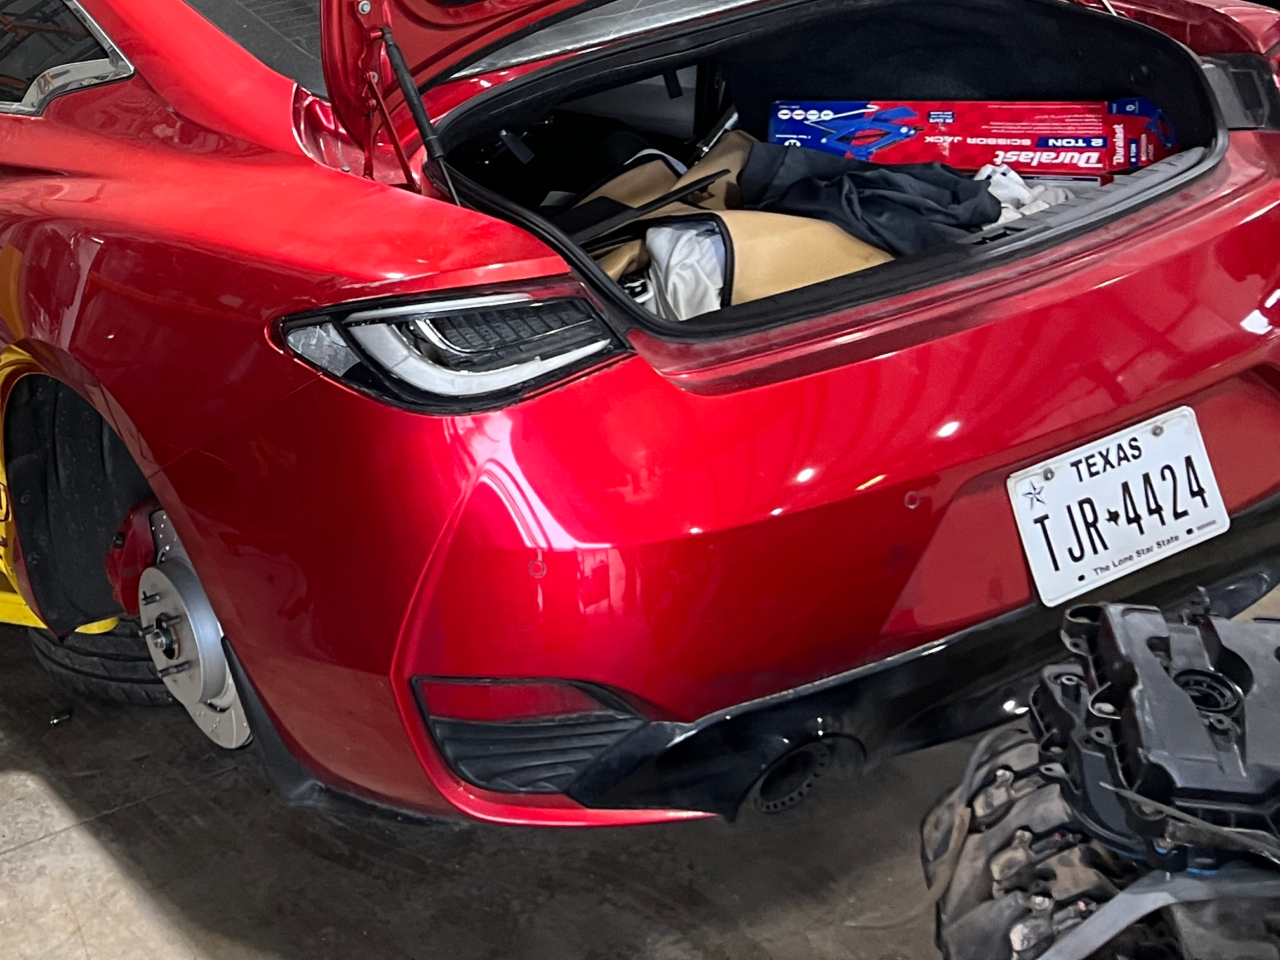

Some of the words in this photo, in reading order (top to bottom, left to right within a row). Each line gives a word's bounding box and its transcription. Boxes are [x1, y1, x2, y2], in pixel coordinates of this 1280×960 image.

[924, 136, 963, 144] JACK
[966, 137, 1032, 145] SCISSOR
[1048, 138, 1086, 147] TON
[1090, 138, 1103, 147] 2
[1112, 123, 1125, 166] Duralast
[995, 150, 1103, 168] Duralast
[1070, 436, 1142, 482] TEXAS
[1092, 564, 1111, 576] The
[1112, 553, 1134, 567] Lone
[1135, 546, 1154, 560] Star
[1156, 534, 1180, 550] State
